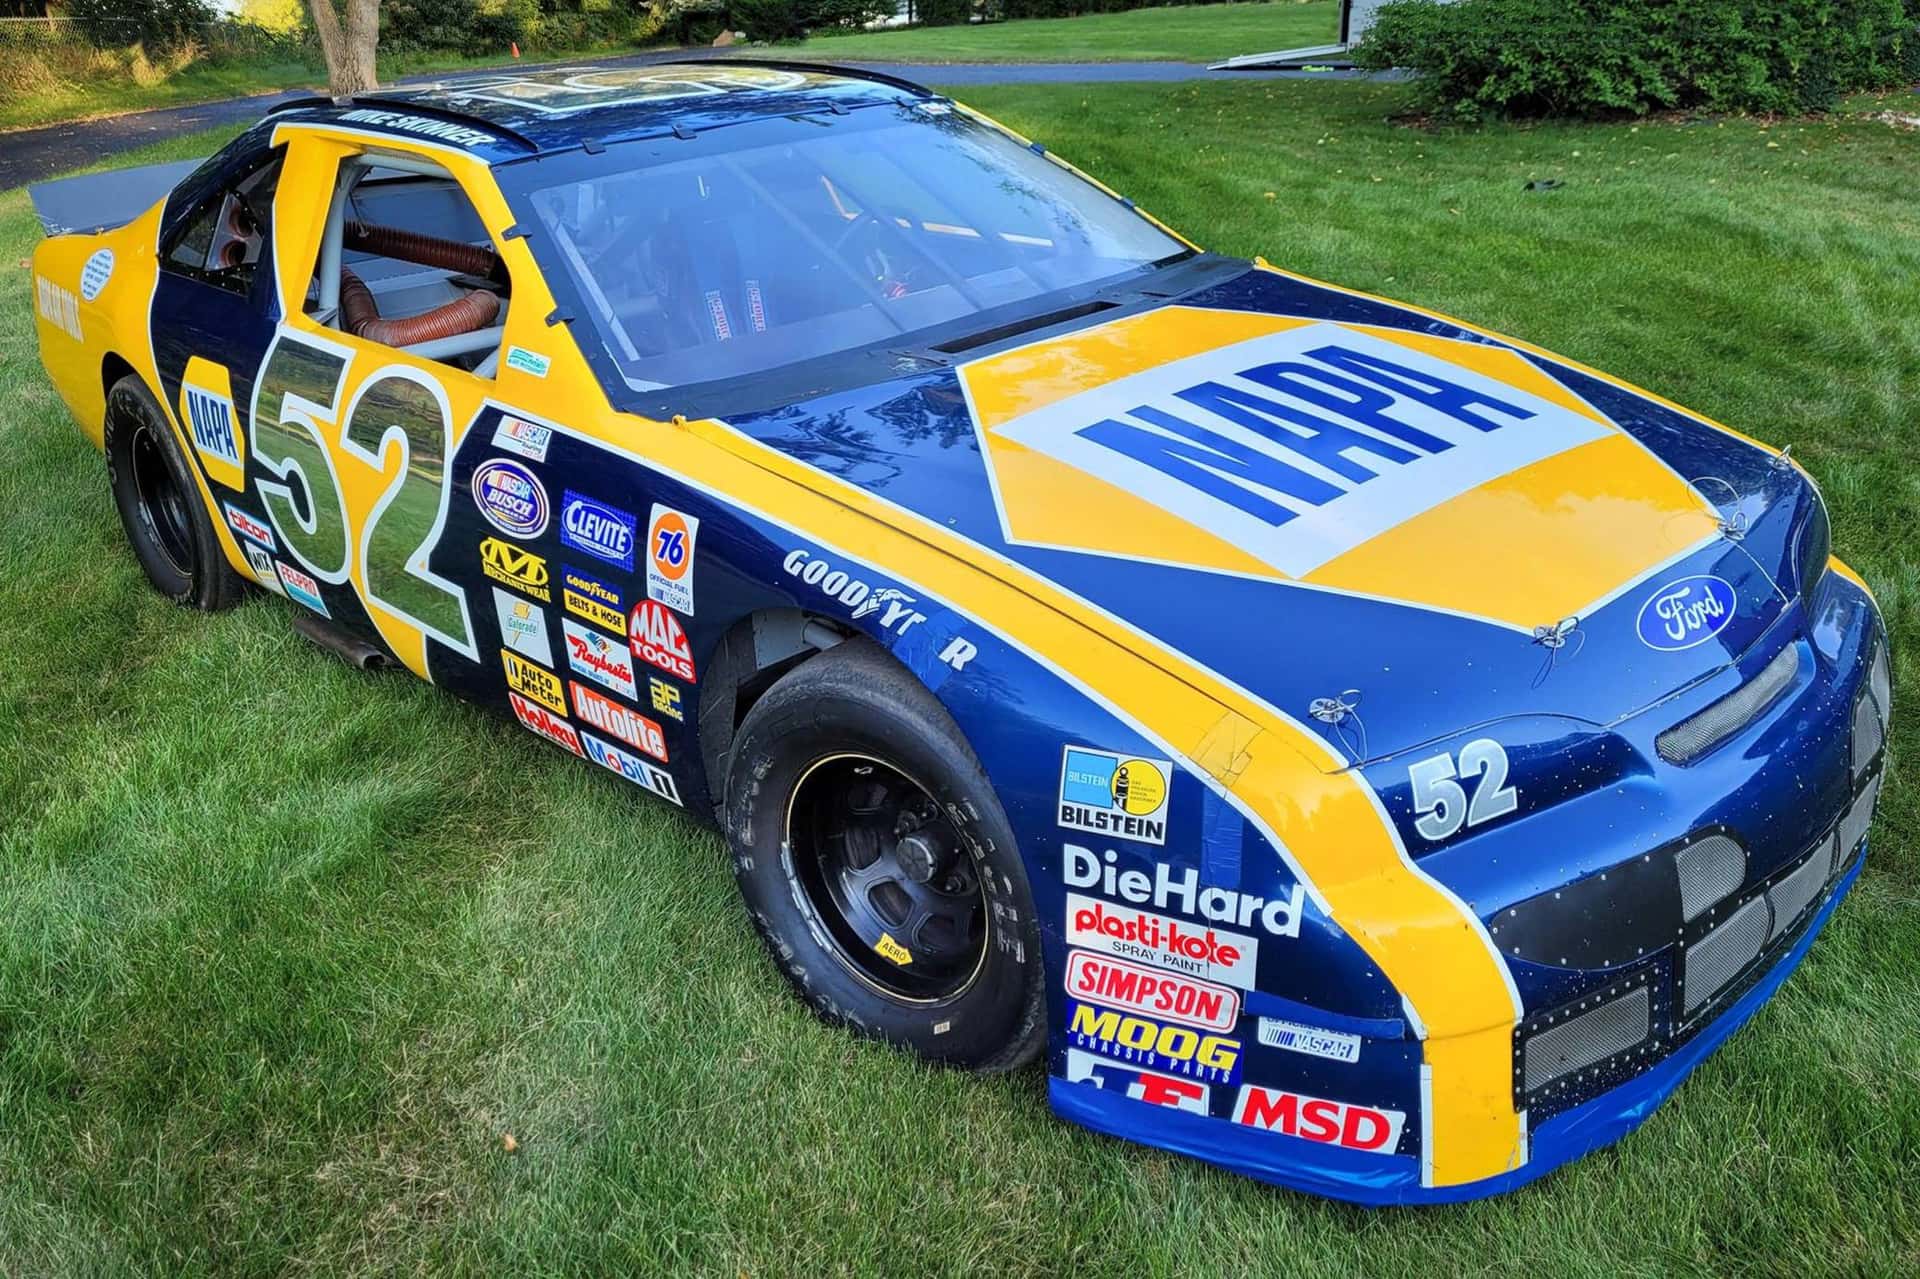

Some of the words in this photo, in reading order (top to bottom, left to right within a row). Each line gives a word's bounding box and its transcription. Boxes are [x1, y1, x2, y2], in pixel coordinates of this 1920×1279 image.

[387, 115, 497, 146] SKINNER
[188, 390, 238, 461] NAPA
[1073, 345, 1538, 527] NAPA
[250, 324, 480, 663] 52
[487, 488, 534, 518] BUSCH
[230, 510, 273, 546] tilton
[566, 500, 627, 552] CLEVITE
[657, 530, 685, 566] 76
[251, 552, 273, 572] WIX
[649, 573, 673, 589] OFFICIAL
[674, 583, 689, 596] FUEL
[566, 574, 619, 604] GOODYEAR
[569, 594, 591, 613] BELTS
[592, 604, 599, 617] &
[600, 609, 622, 628] HOSE
[783, 550, 978, 671] GOODYR
[1655, 585, 1725, 641] Ford
[630, 602, 692, 662] MAC
[521, 664, 553, 690] Auto
[567, 633, 632, 684] Raybestos
[632, 641, 694, 680] TOOLS
[522, 678, 562, 706] Meter
[511, 695, 584, 757] Holley
[575, 684, 664, 760] Autolite
[587, 738, 650, 787] Mobil
[654, 774, 670, 797] 1
[1067, 771, 1108, 787] BILSTEIN
[1408, 738, 1517, 840] 52
[1061, 805, 1164, 840] BILSTEIN
[1064, 843, 1306, 938] DieHard
[882, 942, 907, 961] AERO
[1075, 904, 1240, 967] plasti-kote
[1112, 941, 1156, 961] SPRAY
[1163, 954, 1204, 974] PAINT
[1079, 961, 1223, 1021] SIMPSON
[1071, 1004, 1241, 1071] MOOG
[1077, 1034, 1155, 1065] CHASSIS
[1170, 1058, 1231, 1084] PARTS
[1294, 1033, 1354, 1059] NASCAR
[1241, 1087, 1391, 1150] MSD
